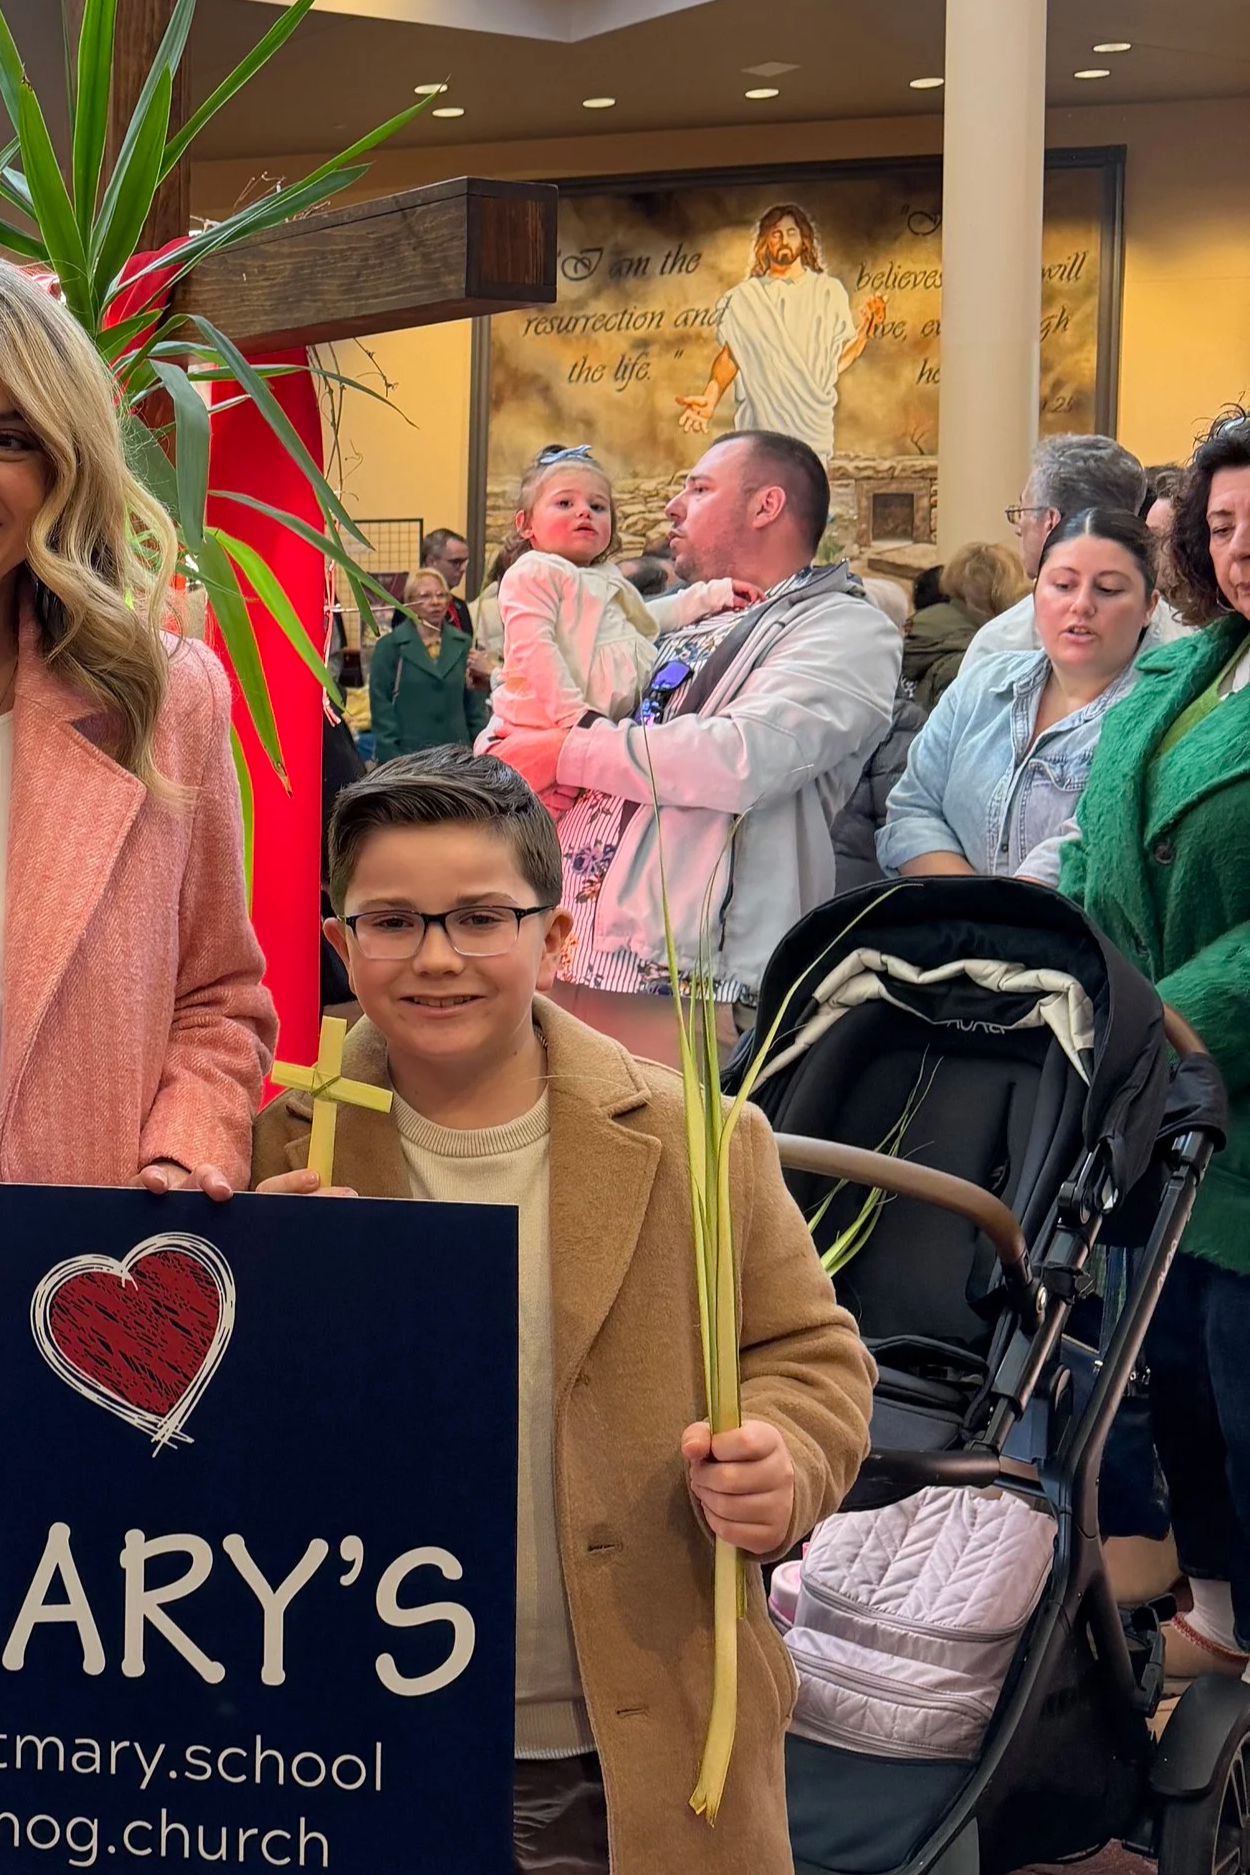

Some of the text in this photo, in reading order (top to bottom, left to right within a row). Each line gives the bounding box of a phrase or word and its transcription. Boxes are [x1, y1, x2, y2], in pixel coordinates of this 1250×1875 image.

[609, 257, 651, 279] am
[659, 243, 702, 276] the
[522, 294, 732, 337] resurrection and
[567, 356, 604, 383] the
